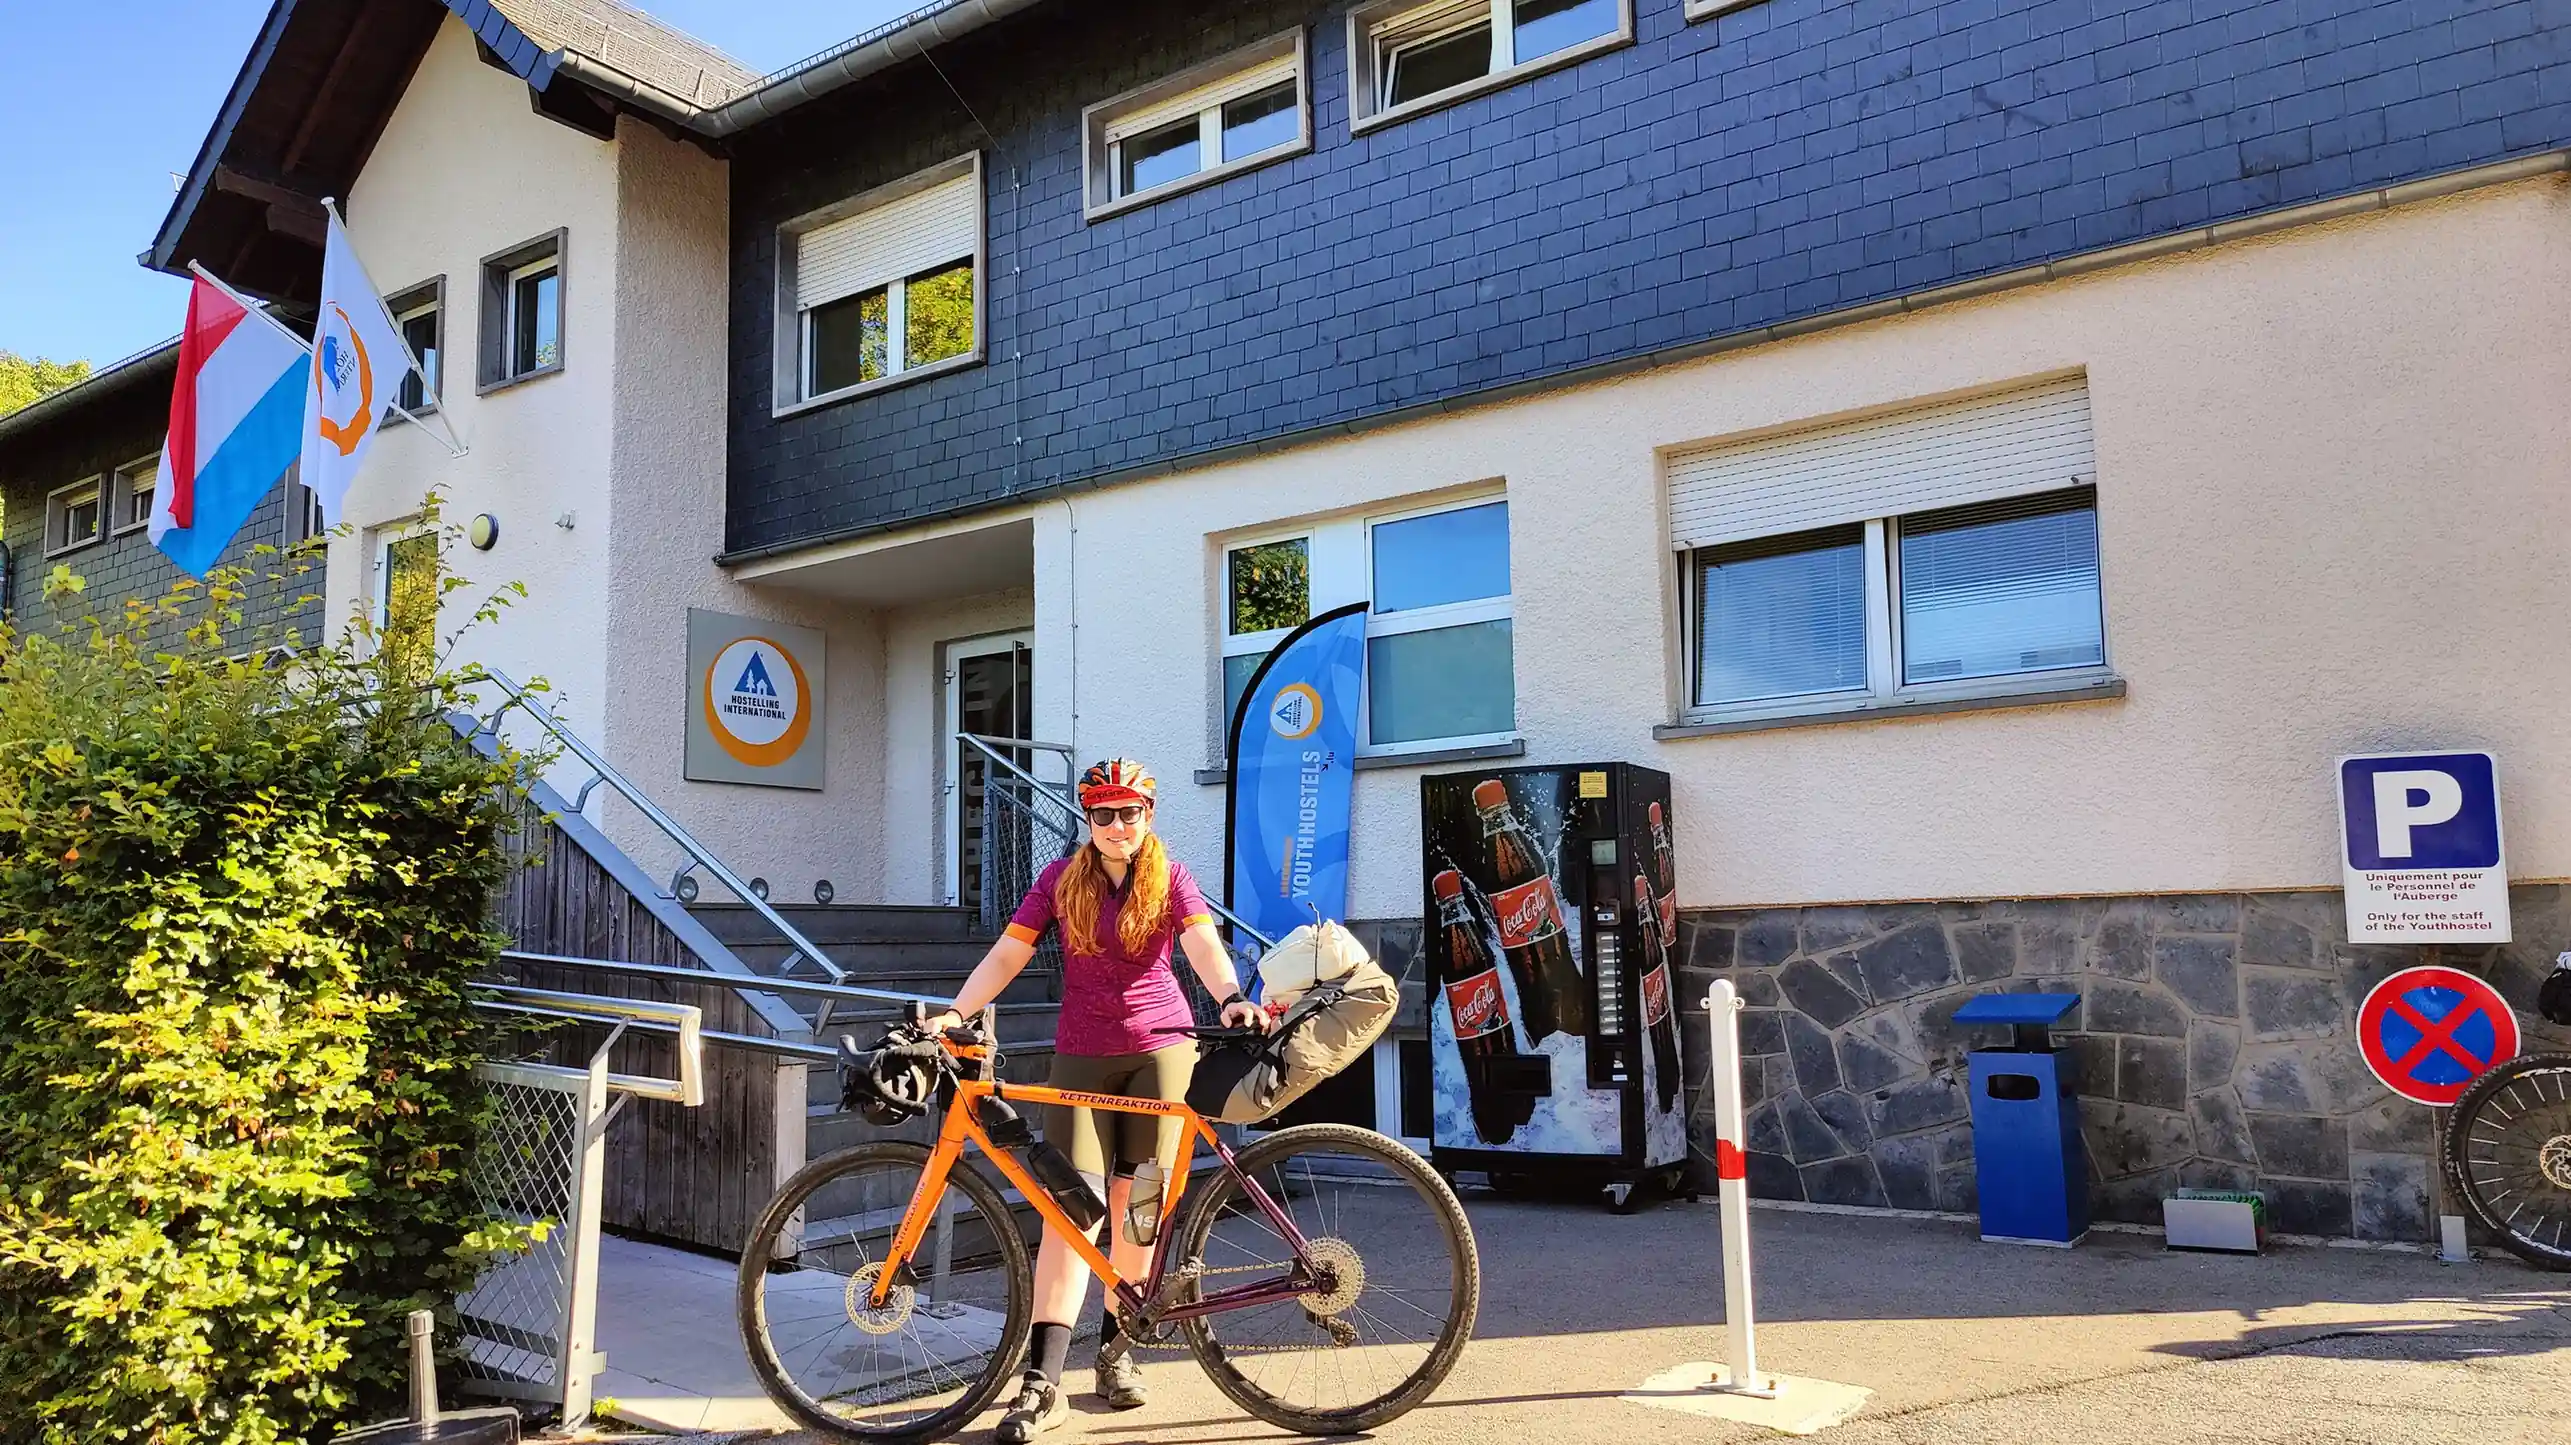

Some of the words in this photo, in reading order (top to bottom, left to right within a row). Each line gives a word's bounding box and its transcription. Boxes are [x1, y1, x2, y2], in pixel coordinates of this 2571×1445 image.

[731, 694, 780, 710] HOSTELLING
[724, 703, 787, 720] INTERNATIONAL
[2372, 769, 2463, 859] P
[2366, 873, 2448, 883] Uniquement
[2452, 872, 2484, 881] pour
[2370, 883, 2382, 891] le
[2387, 882, 2455, 891] Personnel
[2460, 882, 2476, 890] de
[2393, 892, 2458, 902] l'Auberge
[2367, 912, 2397, 922] Only
[2402, 912, 2420, 920] for
[2425, 912, 2447, 920] the
[2451, 911, 2484, 920] staff
[2365, 923, 2378, 931] of
[2383, 923, 2405, 931] the
[2409, 922, 2492, 931] Youthhostel
[1060, 1092, 1171, 1112] KETTENREAKTION
